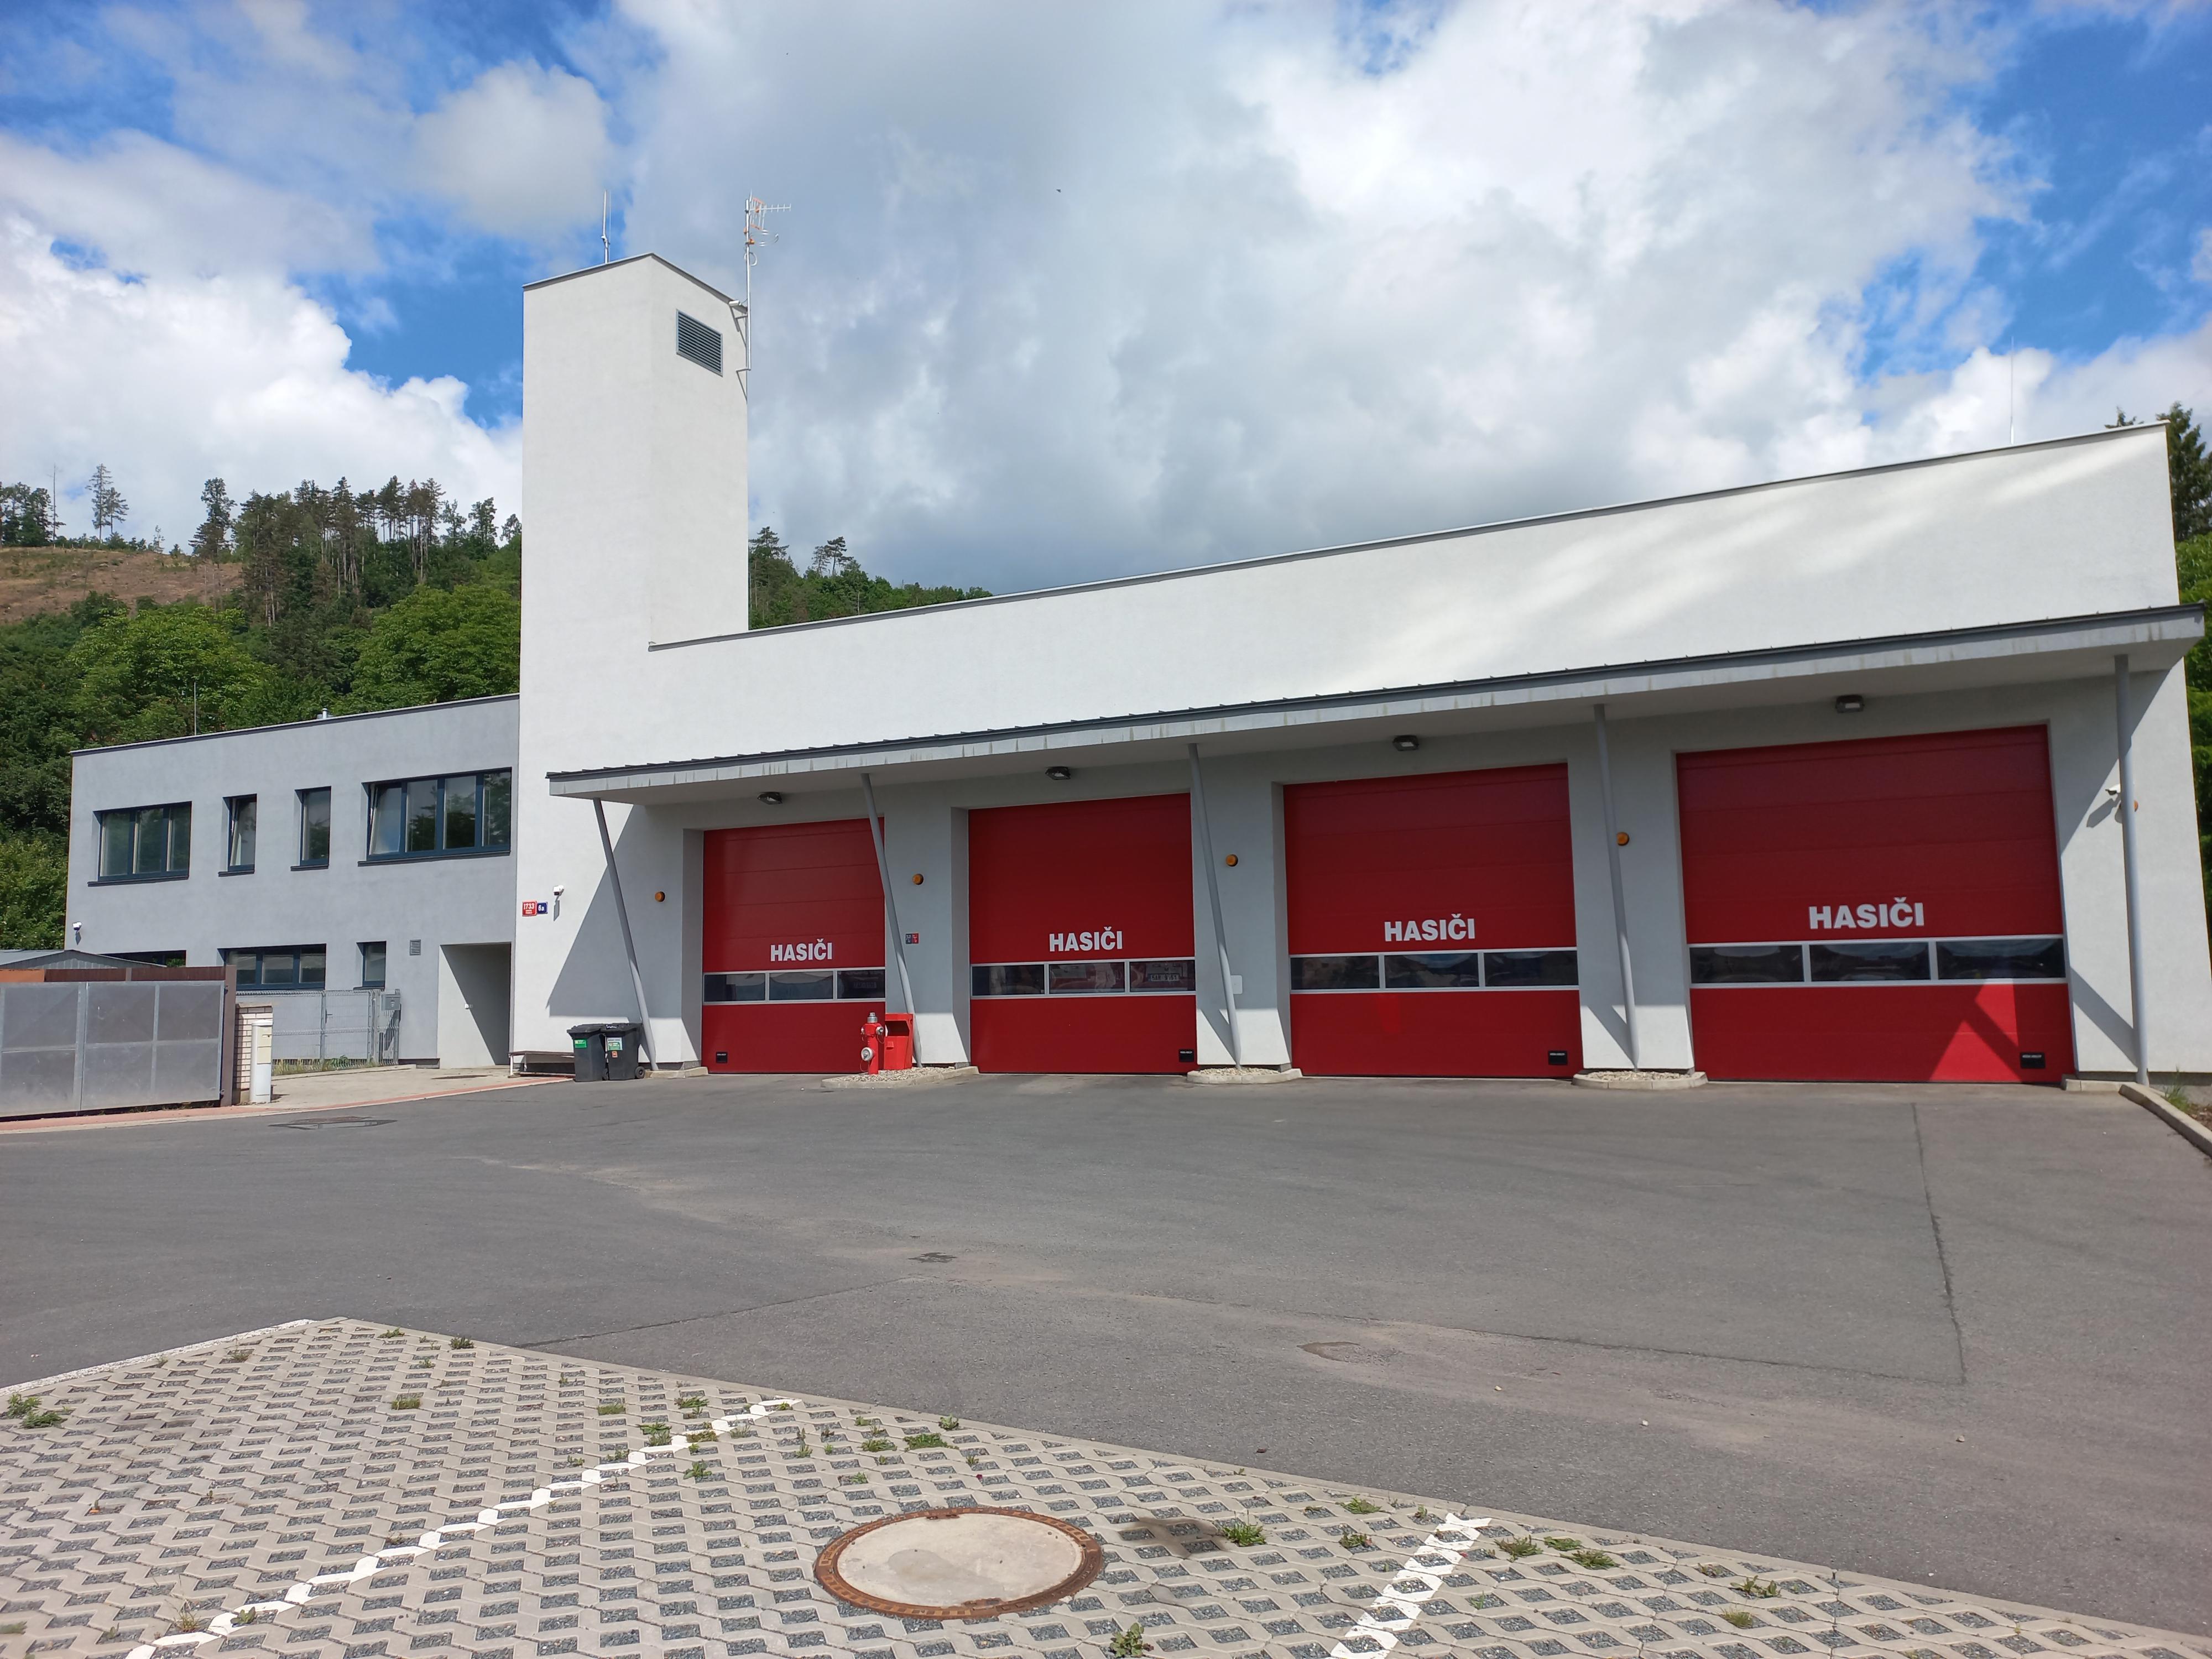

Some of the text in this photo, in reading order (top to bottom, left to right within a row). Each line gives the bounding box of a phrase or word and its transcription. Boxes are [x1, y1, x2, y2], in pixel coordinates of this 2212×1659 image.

[1809, 897, 1924, 929] HASIČI
[1049, 926, 1123, 951] HASIČI
[1384, 914, 1475, 942] HASIČI
[770, 938, 832, 961] HASIČI
